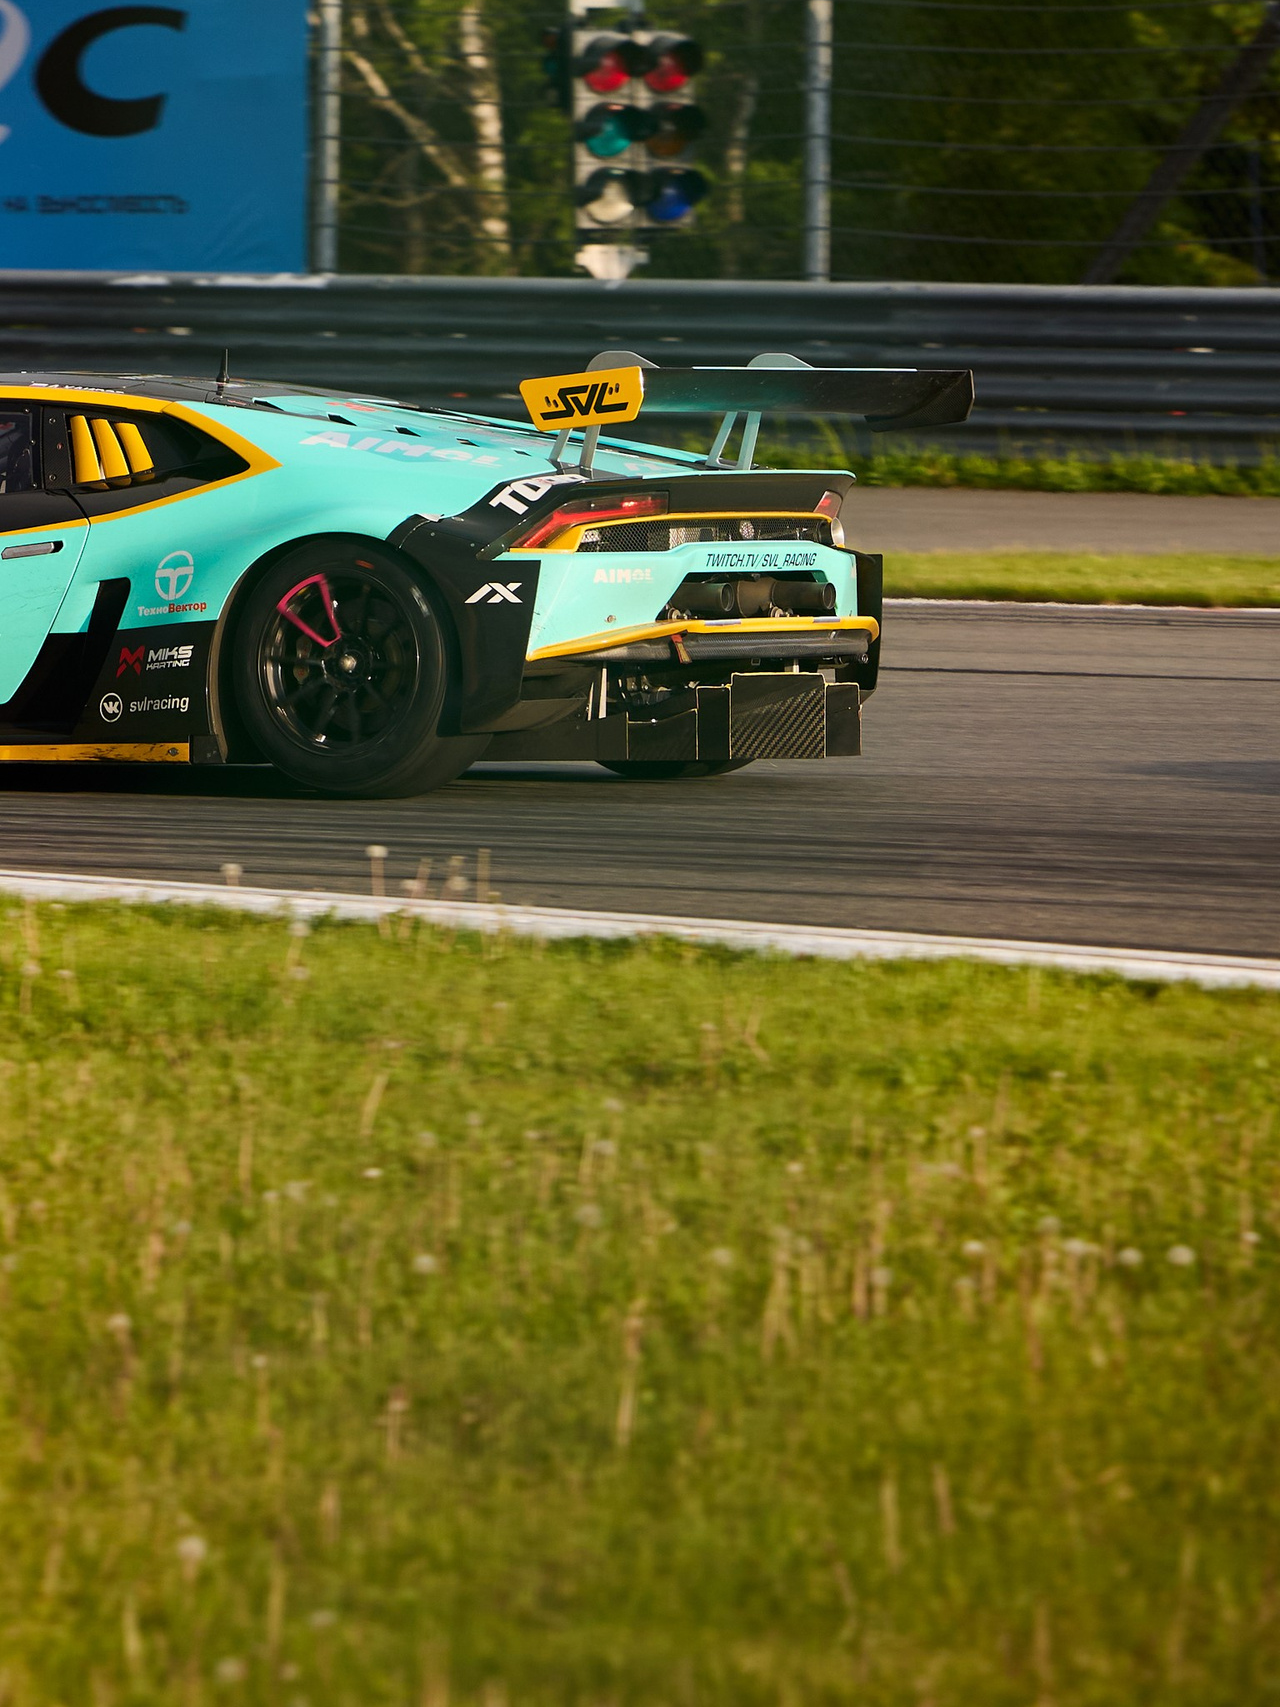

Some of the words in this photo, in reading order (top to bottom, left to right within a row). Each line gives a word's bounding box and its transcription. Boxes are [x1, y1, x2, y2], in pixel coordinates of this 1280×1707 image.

[540, 382, 629, 421] SVL
[298, 430, 504, 468] AIMOL
[593, 567, 654, 584] AIMOL
[137, 601, 208, 617] ТехноВектор
[147, 644, 195, 663] MIKS
[145, 658, 191, 671] KARTING
[129, 694, 190, 713] svlracing
